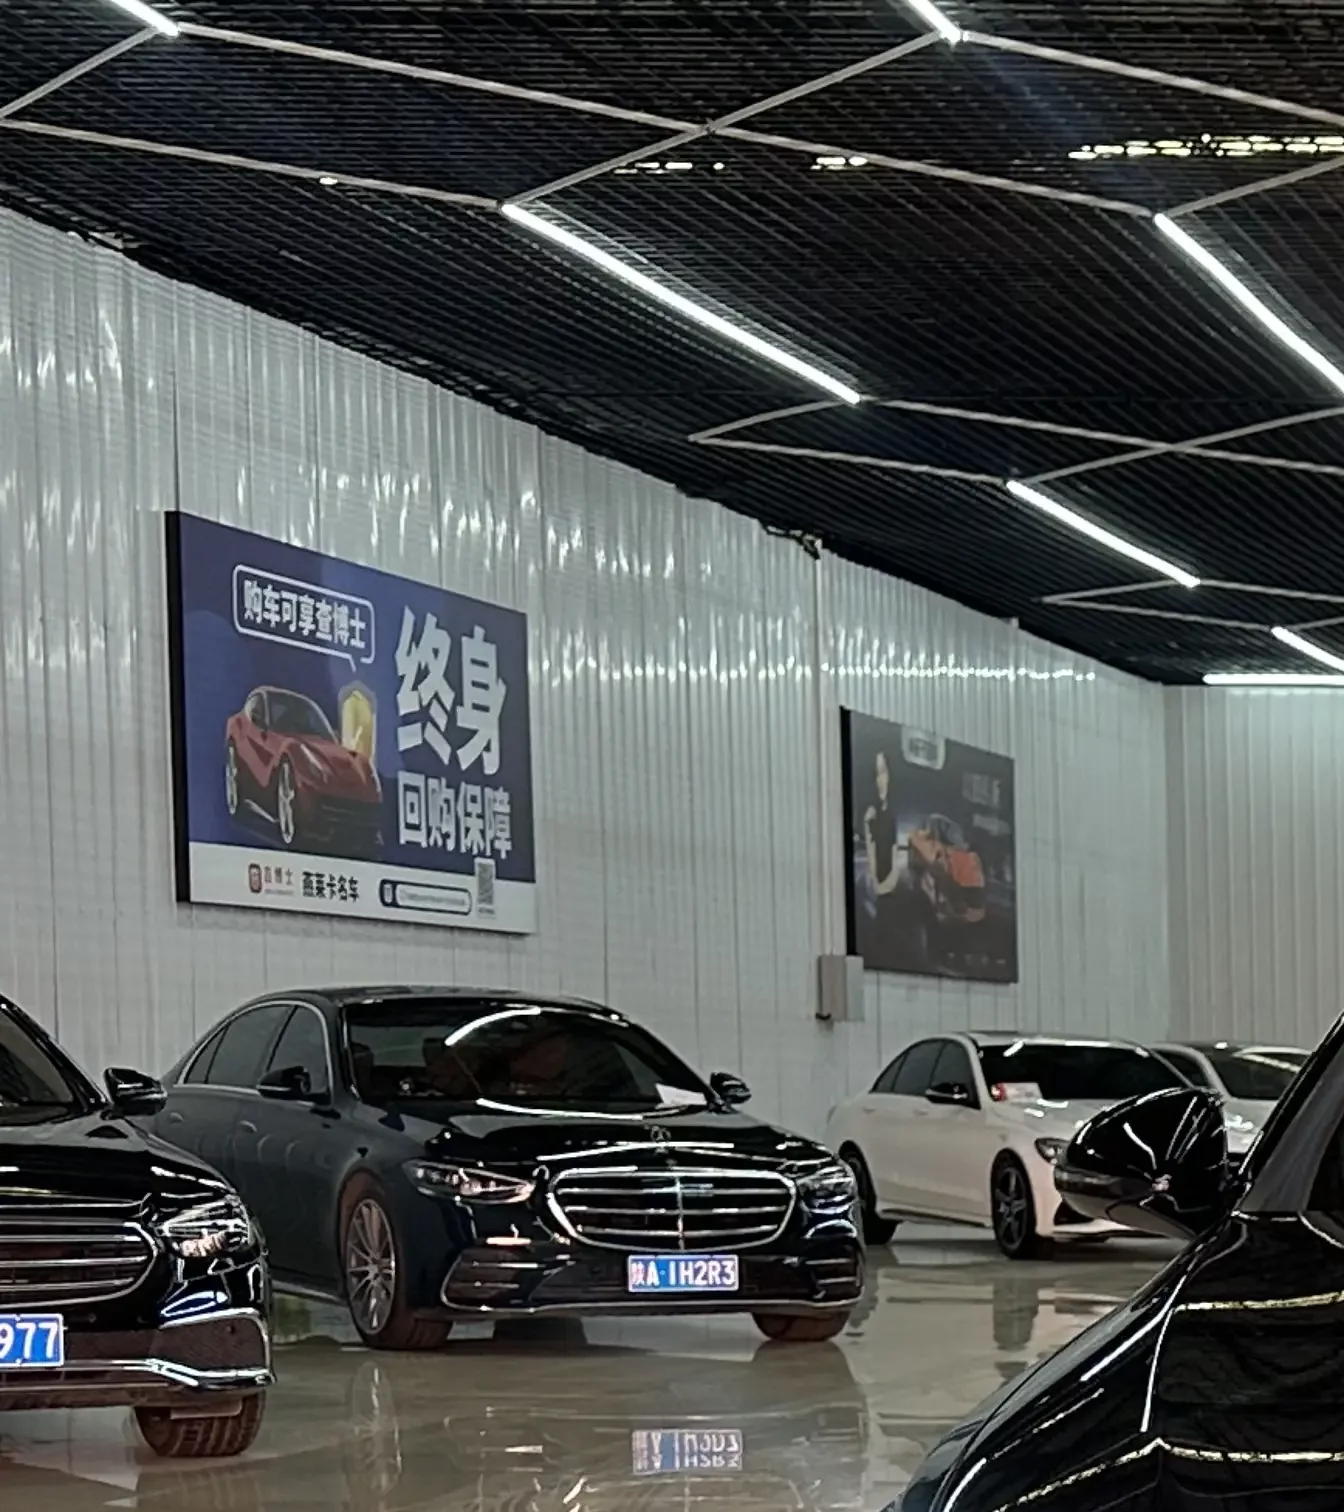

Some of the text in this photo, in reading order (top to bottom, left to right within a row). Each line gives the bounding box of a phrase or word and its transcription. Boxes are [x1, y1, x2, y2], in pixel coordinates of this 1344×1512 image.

[244, 579, 366, 649] 购车可享查博士
[395, 605, 507, 775] 终身
[397, 770, 512, 860] 回购保障
